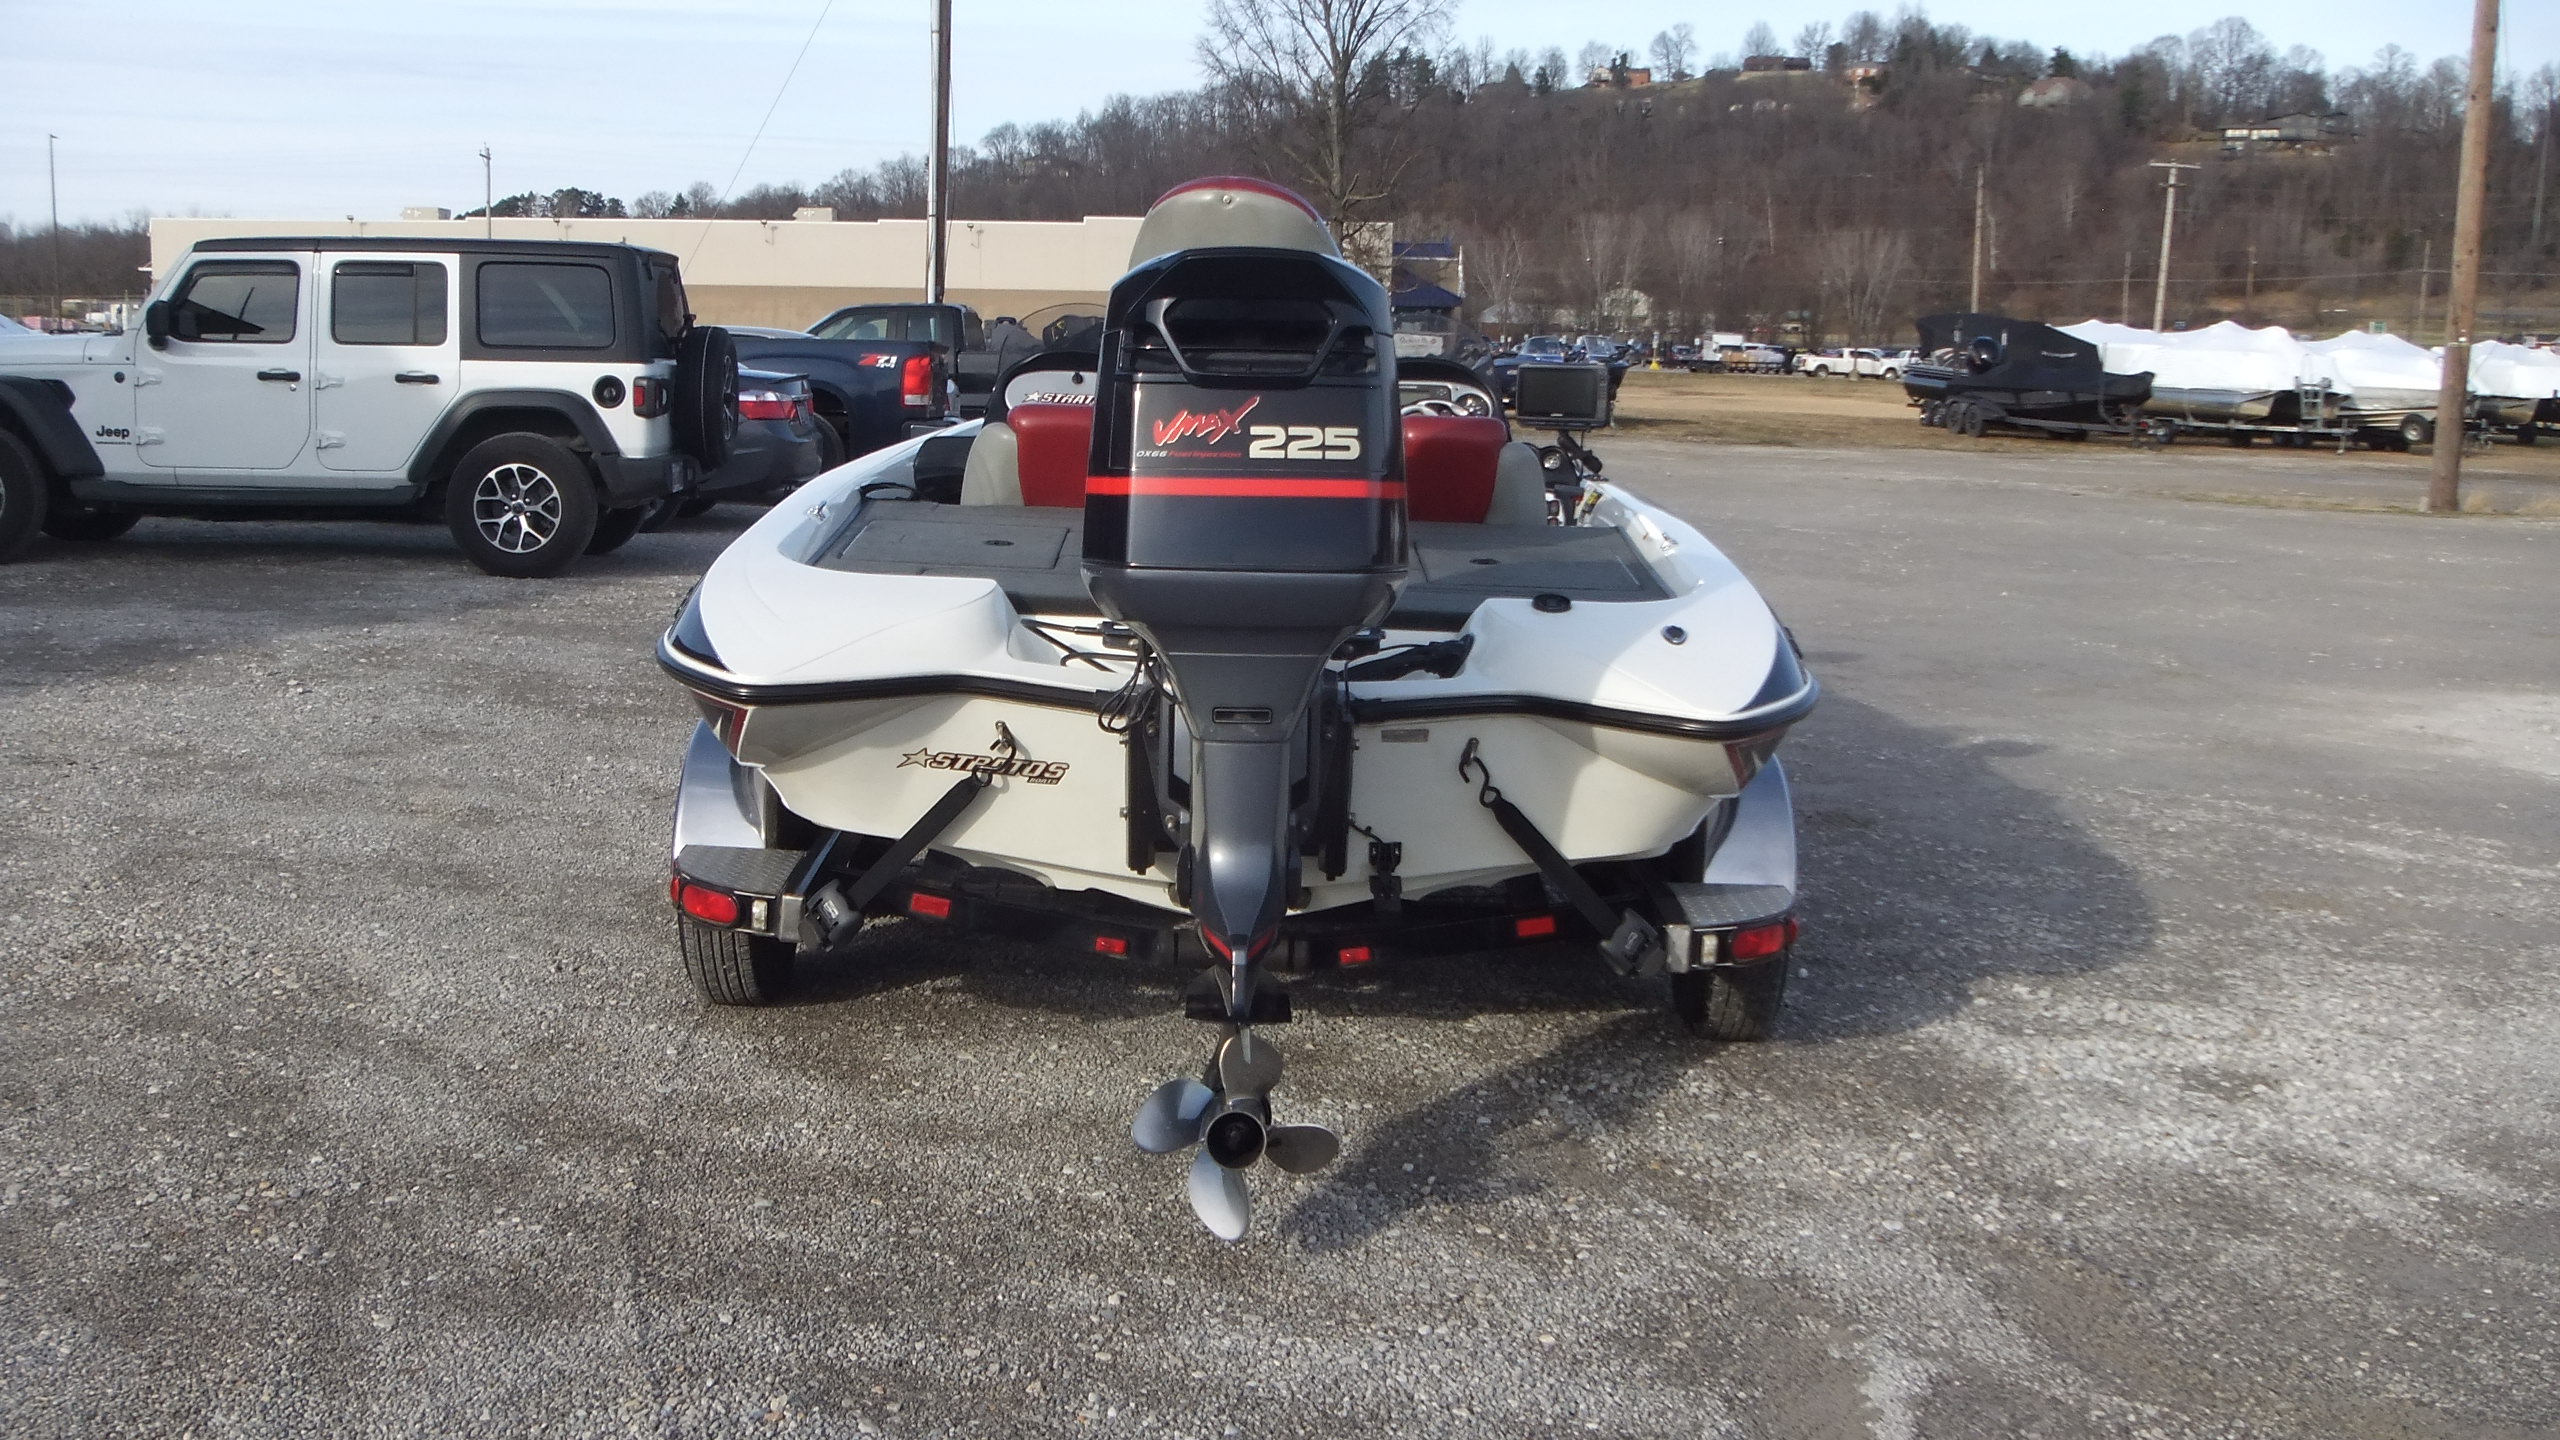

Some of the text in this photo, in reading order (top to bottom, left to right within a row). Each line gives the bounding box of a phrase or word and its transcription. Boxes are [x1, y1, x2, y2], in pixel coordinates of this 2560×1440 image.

[1041, 393, 1095, 405] STRAT
[96, 425, 130, 440] Jeep
[1249, 426, 1360, 461] 225
